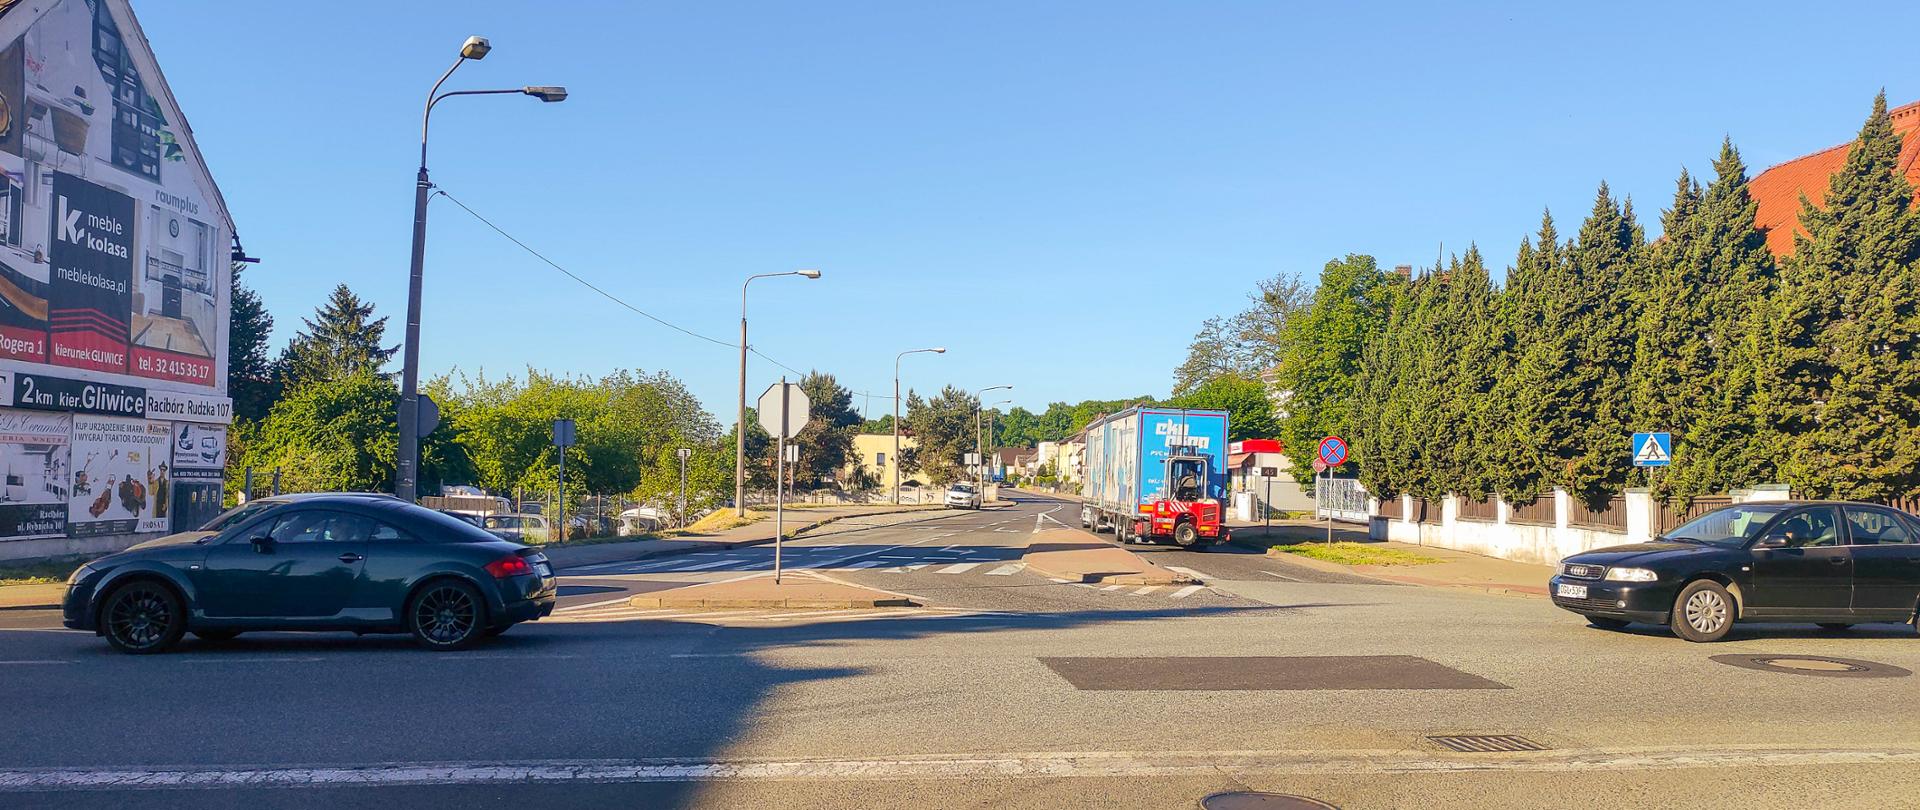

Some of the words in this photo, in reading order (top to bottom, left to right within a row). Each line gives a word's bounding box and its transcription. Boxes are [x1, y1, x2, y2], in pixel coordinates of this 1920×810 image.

[155, 188, 199, 215] raumplus
[88, 212, 122, 236] meble
[87, 235, 128, 259] kolasa
[57, 266, 127, 294] meblekolasa.pl
[37, 340, 43, 355] 1
[55, 343, 91, 360] kierunek
[91, 348, 123, 366] GLIWICE
[138, 356, 153, 371] tel.
[155, 359, 167, 373] 32
[169, 361, 185, 376] 415
[186, 364, 197, 378] 36
[198, 365, 209, 379] 17
[35, 389, 53, 406] km
[82, 384, 144, 414] Gliwice
[148, 396, 185, 414] Racibórz
[187, 400, 215, 416] Rudzka
[216, 403, 230, 417] 107
[75, 421, 88, 430] KUP
[1264, 468, 1274, 476] 45
